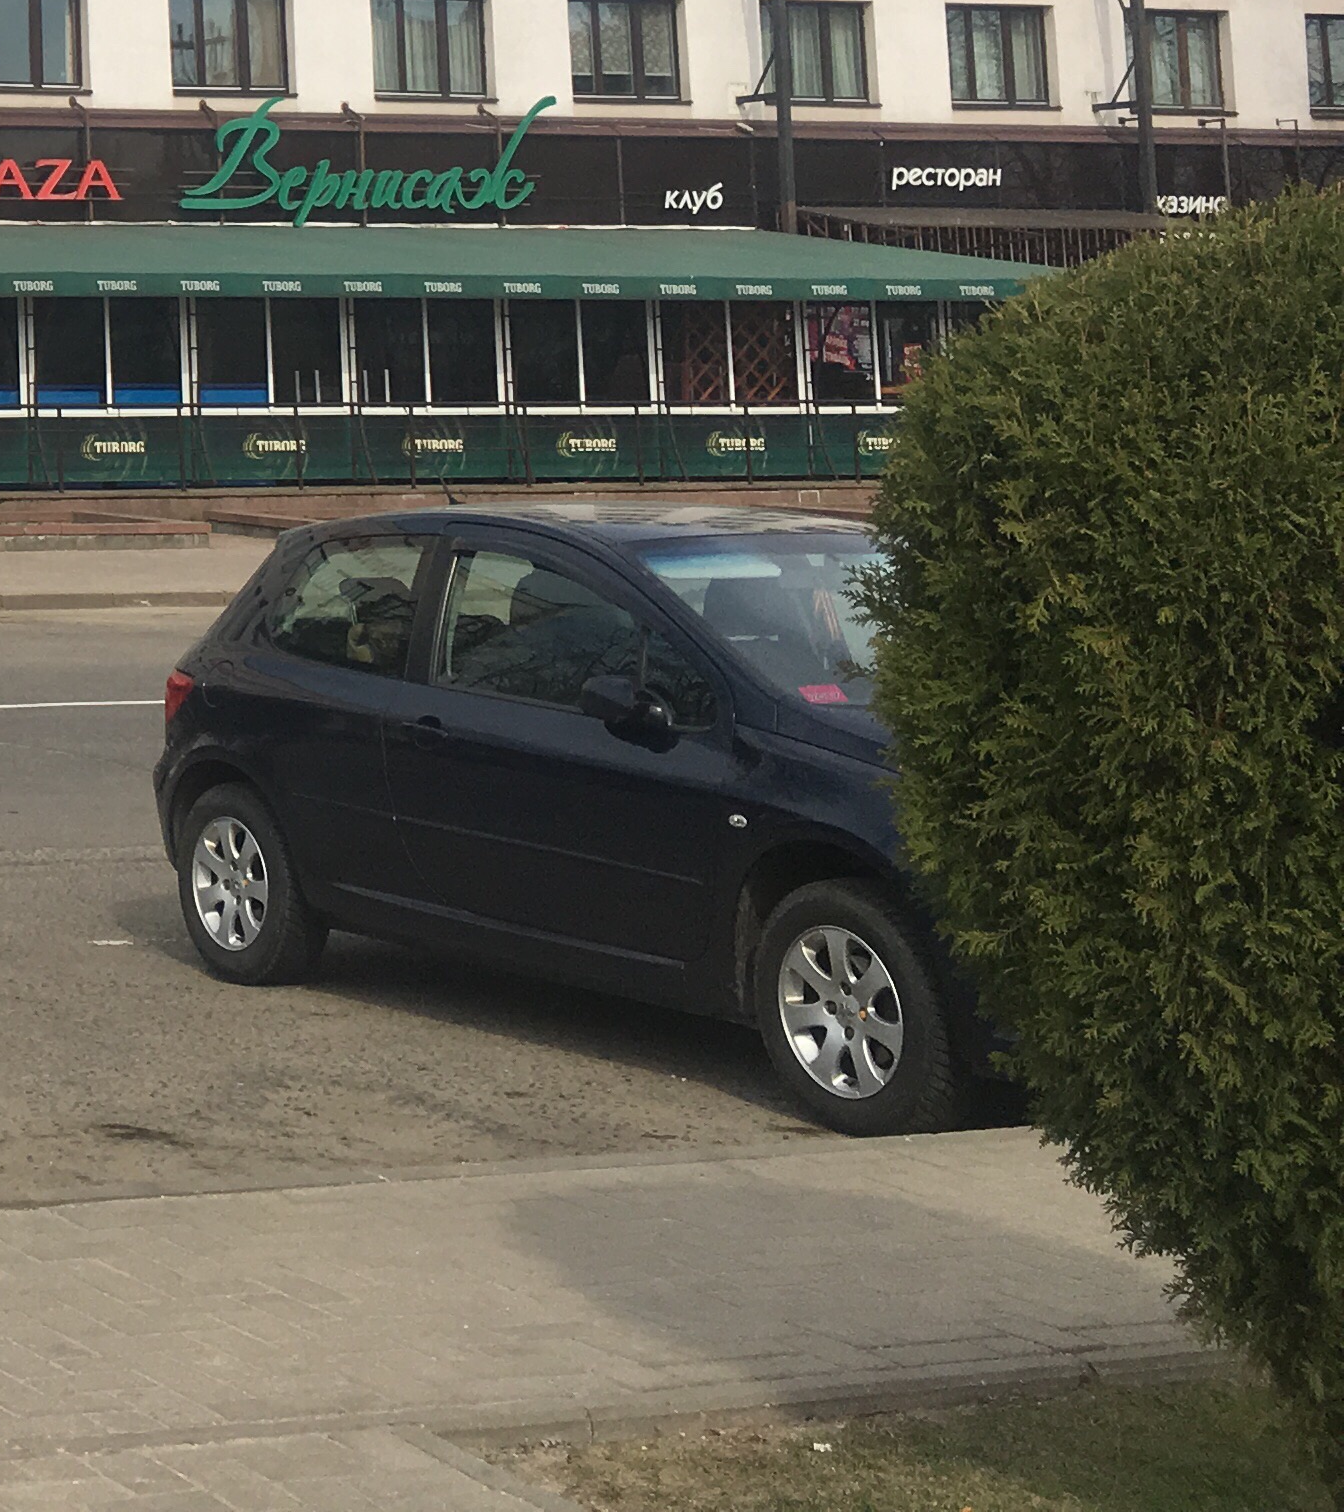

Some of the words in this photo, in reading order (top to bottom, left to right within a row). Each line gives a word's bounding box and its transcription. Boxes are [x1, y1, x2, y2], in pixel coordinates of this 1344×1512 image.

[178, 96, 557, 227] Вернисаж
[891, 165, 1003, 191] ресторан
[664, 182, 724, 211] клуб
[12, 280, 54, 292] TUBORG
[96, 280, 138, 291] TUBORG
[180, 280, 220, 292] TUBORG
[262, 280, 302, 292] TUBORG
[343, 281, 383, 292] TUBORG
[423, 281, 463, 293] TUBORG
[503, 282, 542, 294] TUBORG
[581, 283, 620, 295] TUBORG
[659, 283, 697, 295] TUBORG
[735, 284, 773, 296] TUBORG
[811, 284, 848, 296] TUBORG
[885, 284, 922, 296] TUBORG
[959, 285, 995, 296] TUBORG
[94, 441, 145, 453] TUBORG
[568, 438, 616, 452] TUBORG
